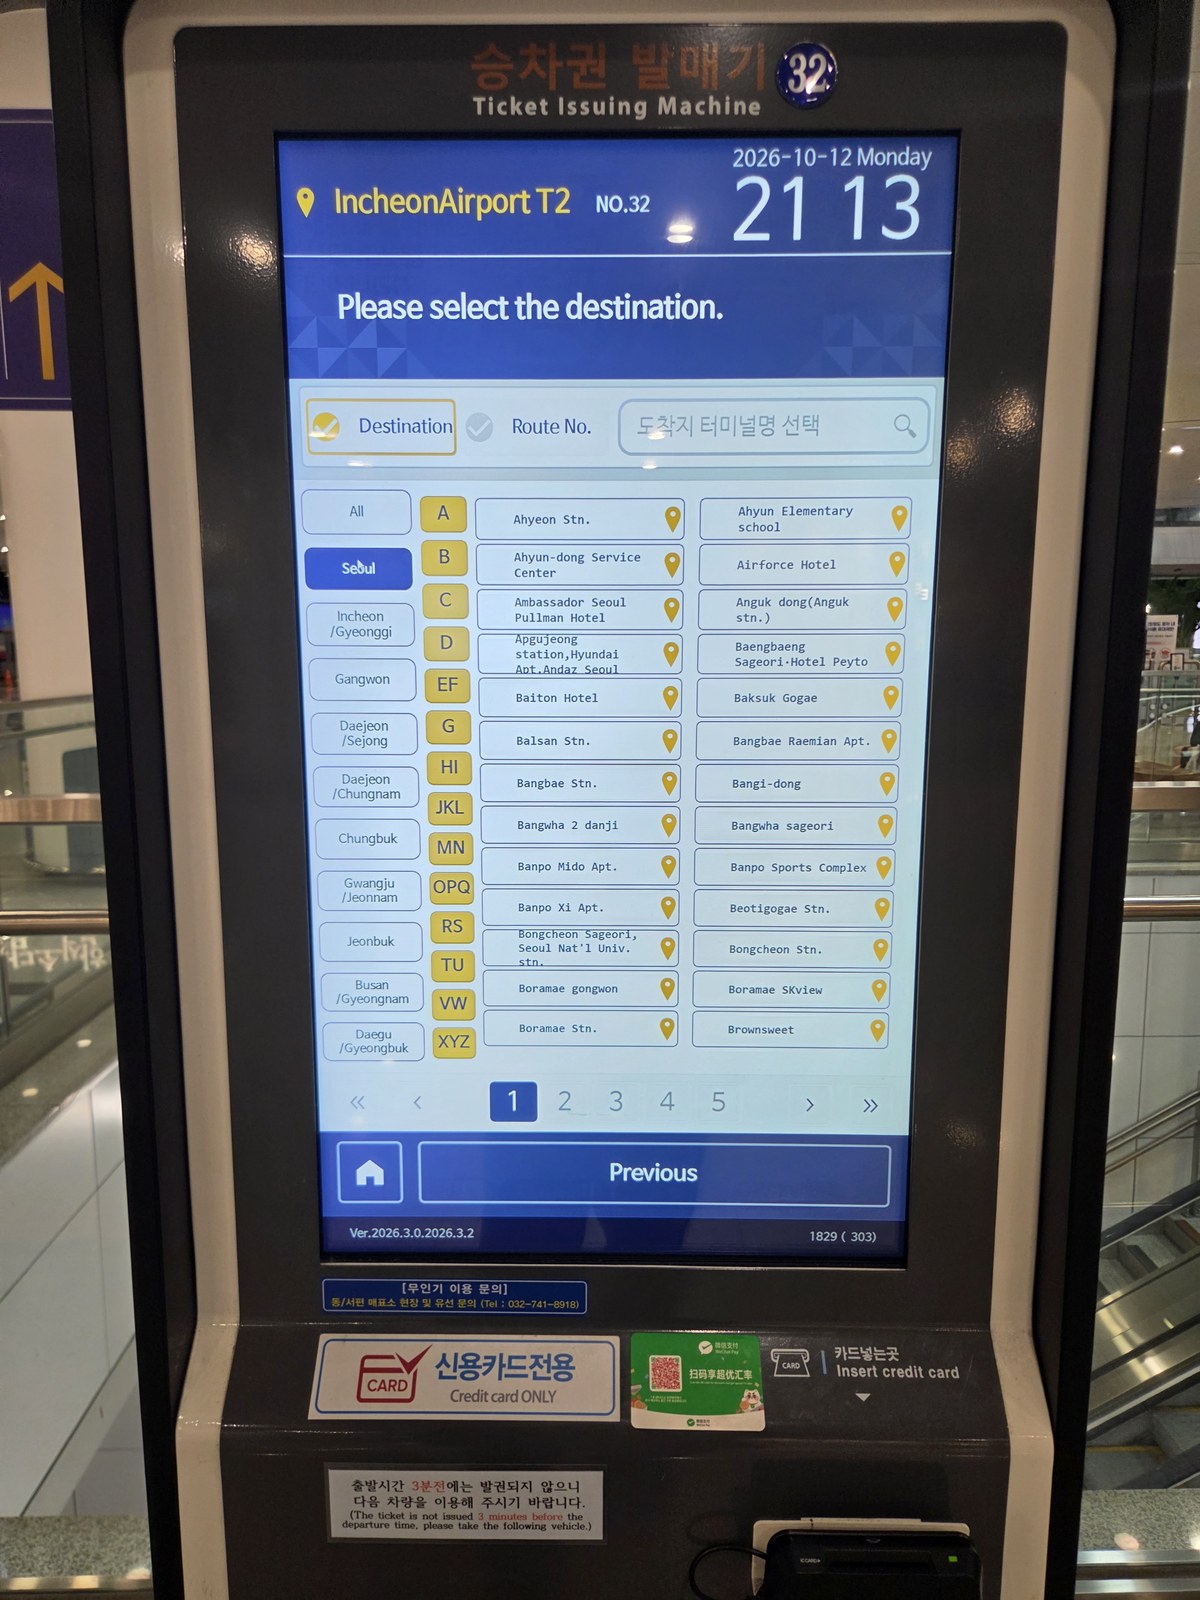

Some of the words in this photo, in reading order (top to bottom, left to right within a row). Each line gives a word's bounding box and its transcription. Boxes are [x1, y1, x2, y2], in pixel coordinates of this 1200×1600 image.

[470, 41, 606, 91] 승차권
[631, 41, 766, 92] 발매기
[787, 53, 827, 94] 32
[473, 96, 548, 117] Ticket
[558, 96, 647, 120] Issuing
[658, 96, 761, 117] Machine
[733, 148, 852, 168] 2026-10-12
[857, 146, 932, 171] Monday
[335, 187, 531, 221] IncheonAirport
[535, 187, 570, 214] T2
[596, 195, 650, 213] NO.32
[733, 175, 803, 241] 21
[844, 174, 920, 240] 13
[338, 292, 423, 319] Please
[429, 291, 509, 320] select
[514, 292, 560, 320] the
[565, 292, 723, 320] destination.
[360, 417, 453, 434] Destination
[513, 418, 560, 434] Route
[565, 418, 591, 434] No.
[637, 415, 693, 438] 도착지
[701, 415, 775, 437] 터미널명
[782, 414, 819, 437] 선택
[350, 505, 364, 517] All
[437, 505, 449, 520] A
[738, 506, 774, 519] Ahyun
[782, 506, 853, 518] Elementary
[513, 514, 556, 527] Ahyeon
[563, 515, 590, 524] Stn.
[739, 522, 780, 532] school
[439, 549, 450, 564] B
[514, 552, 584, 564] Ahyun-dong
[592, 552, 641, 562] Service
[342, 560, 375, 575] Seoul
[514, 568, 556, 578] Center
[440, 592, 451, 607] C
[515, 597, 584, 607] Ambassador
[592, 597, 626, 607] Seoul
[736, 597, 771, 609] Anguk
[779, 596, 849, 609] dong(Anguk
[337, 610, 384, 622] Incheon
[515, 613, 564, 622] Pullman
[571, 613, 605, 623] Hotel
[736, 612, 770, 624] stn.)
[330, 625, 392, 640] /Gyeonggi
[441, 635, 453, 650] D
[515, 635, 578, 646] Apgujeong
[736, 641, 806, 654] Baengbaeng
[516, 649, 619, 661] station,Hyundai
[585, 664, 618, 673] Seoul
[833, 657, 868, 669] Peyto
[335, 673, 390, 687] Gangwon
[438, 677, 458, 692] EF
[734, 693, 775, 703] Baksuk
[783, 693, 818, 705] Gogae
[340, 720, 389, 734] Daejeon
[442, 718, 454, 733] G
[342, 735, 388, 749] /Sejong
[733, 736, 781, 748] Bangbae
[789, 736, 837, 746] Raemian
[843, 737, 870, 748] Apt.
[441, 760, 458, 774] HI
[342, 774, 390, 787] Daejeon
[332, 788, 401, 802] /Chungnam
[436, 800, 464, 814] JKL
[339, 833, 398, 846] Chungbuk
[438, 840, 464, 854] MN
[731, 863, 765, 874] Banpo
[771, 863, 812, 874] Sports
[819, 863, 867, 874] Complex
[344, 878, 395, 891] Gwangju
[433, 880, 470, 894] OPQ
[342, 892, 398, 903] /Jeonnam
[442, 919, 463, 933] RS
[347, 936, 395, 947] Jeonbuk
[518, 929, 578, 941] Bongcheon
[585, 929, 639, 941] Sageori,
[519, 943, 551, 952] Seoul
[558, 943, 591, 953] Nat'l
[598, 944, 630, 953] Univ.
[441, 958, 464, 972] TU
[356, 980, 389, 990] Busan
[729, 985, 775, 994] Boramae
[782, 985, 823, 994] SKview
[336, 993, 409, 1006] /Gyeongnam
[439, 996, 467, 1010] VW
[356, 1029, 392, 1042] Daegu
[728, 1025, 794, 1034] Brownsweet
[438, 1035, 470, 1048] XYZ
[339, 1043, 409, 1056] /Gyeongbuk
[508, 1090, 516, 1111] 1
[558, 1091, 571, 1111] 2
[609, 1090, 623, 1112] 3
[660, 1091, 675, 1111] 4
[712, 1092, 725, 1112] 5
[610, 1162, 698, 1182] Previous
[349, 1228, 474, 1238] Ver.2026.3.0.2026.3.2
[810, 1231, 837, 1242] 1829
[851, 1232, 877, 1243] 303)
[402, 1282, 443, 1294] [무인기
[450, 1283, 472, 1295] 이용
[479, 1283, 507, 1295] 문의]
[457, 1299, 476, 1308] 문의
[481, 1299, 497, 1308] (Tel
[835, 1346, 900, 1362] 카드넣는곳
[435, 1352, 575, 1382] 신용카드전용
[782, 1361, 801, 1370] CARD
[837, 1364, 878, 1378] Insert
[882, 1365, 924, 1378] credit
[928, 1366, 960, 1379] card
[688, 1368, 753, 1380] 扫码享超优汇率
[367, 1379, 408, 1392] CARD
[450, 1389, 489, 1403] Credit
[491, 1389, 519, 1403] card
[521, 1390, 557, 1403] ONLY
[352, 1479, 405, 1492] 출발시간
[480, 1480, 532, 1493] 발권되지
[541, 1480, 579, 1493] 않으니
[354, 1495, 380, 1508] 다음
[387, 1496, 427, 1509] 차량을
[434, 1496, 473, 1509] 이용해
[481, 1496, 520, 1509] 주시기
[528, 1496, 585, 1509] 바랍니다.
[350, 1510, 374, 1520] (The
[378, 1512, 405, 1520] ticket
[409, 1512, 418, 1520] is
[443, 1512, 473, 1520] issued
[567, 1513, 583, 1521] the
[342, 1520, 390, 1530] departure
[394, 1521, 418, 1530] time,
[423, 1521, 454, 1531] please
[458, 1522, 479, 1530] take
[483, 1522, 499, 1530] the
[503, 1522, 547, 1531] following
[551, 1522, 592, 1531] vehicle.)
